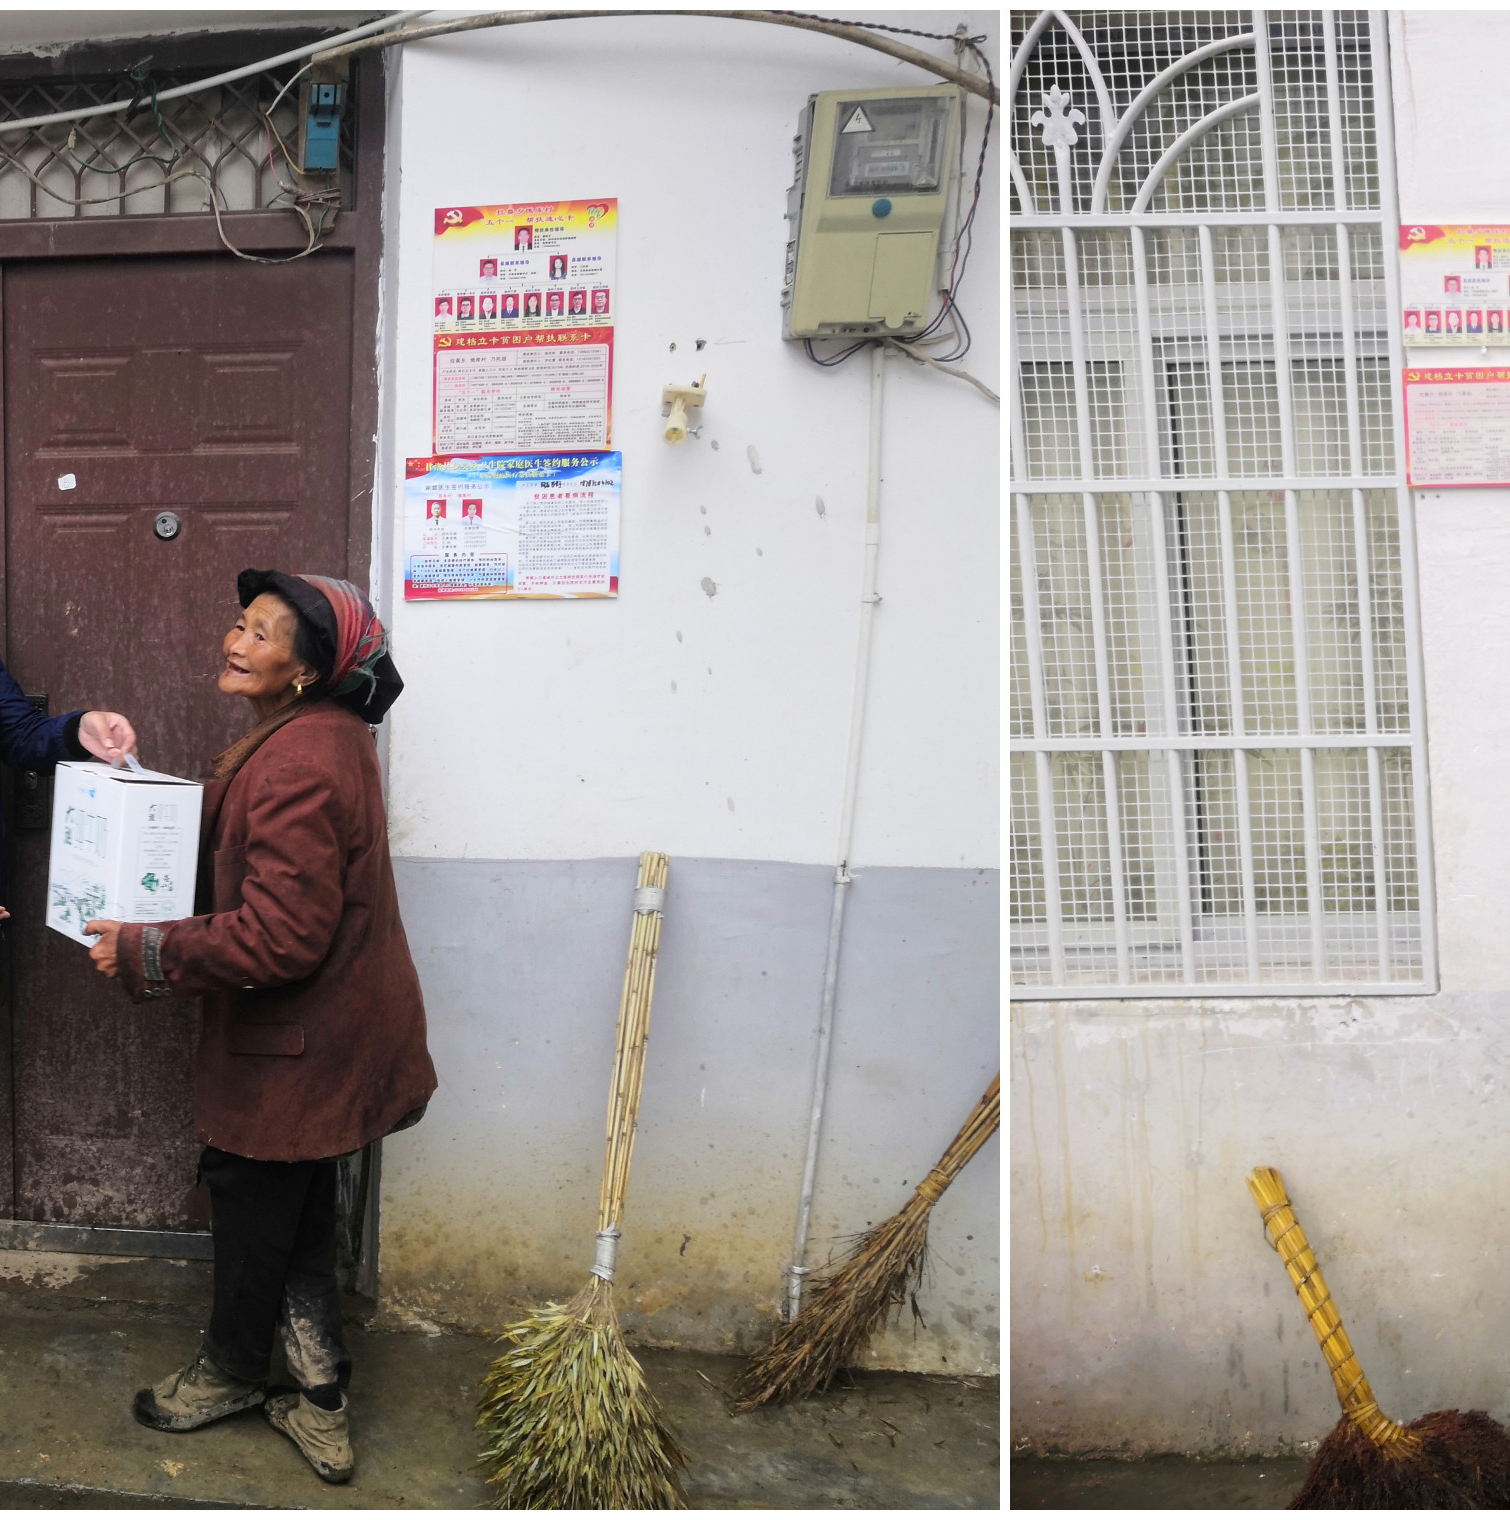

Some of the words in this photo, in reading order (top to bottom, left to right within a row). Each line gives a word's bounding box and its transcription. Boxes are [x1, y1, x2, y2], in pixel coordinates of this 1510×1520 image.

[455, 332, 592, 347] 建档立卡贫困户帮扶联系卡
